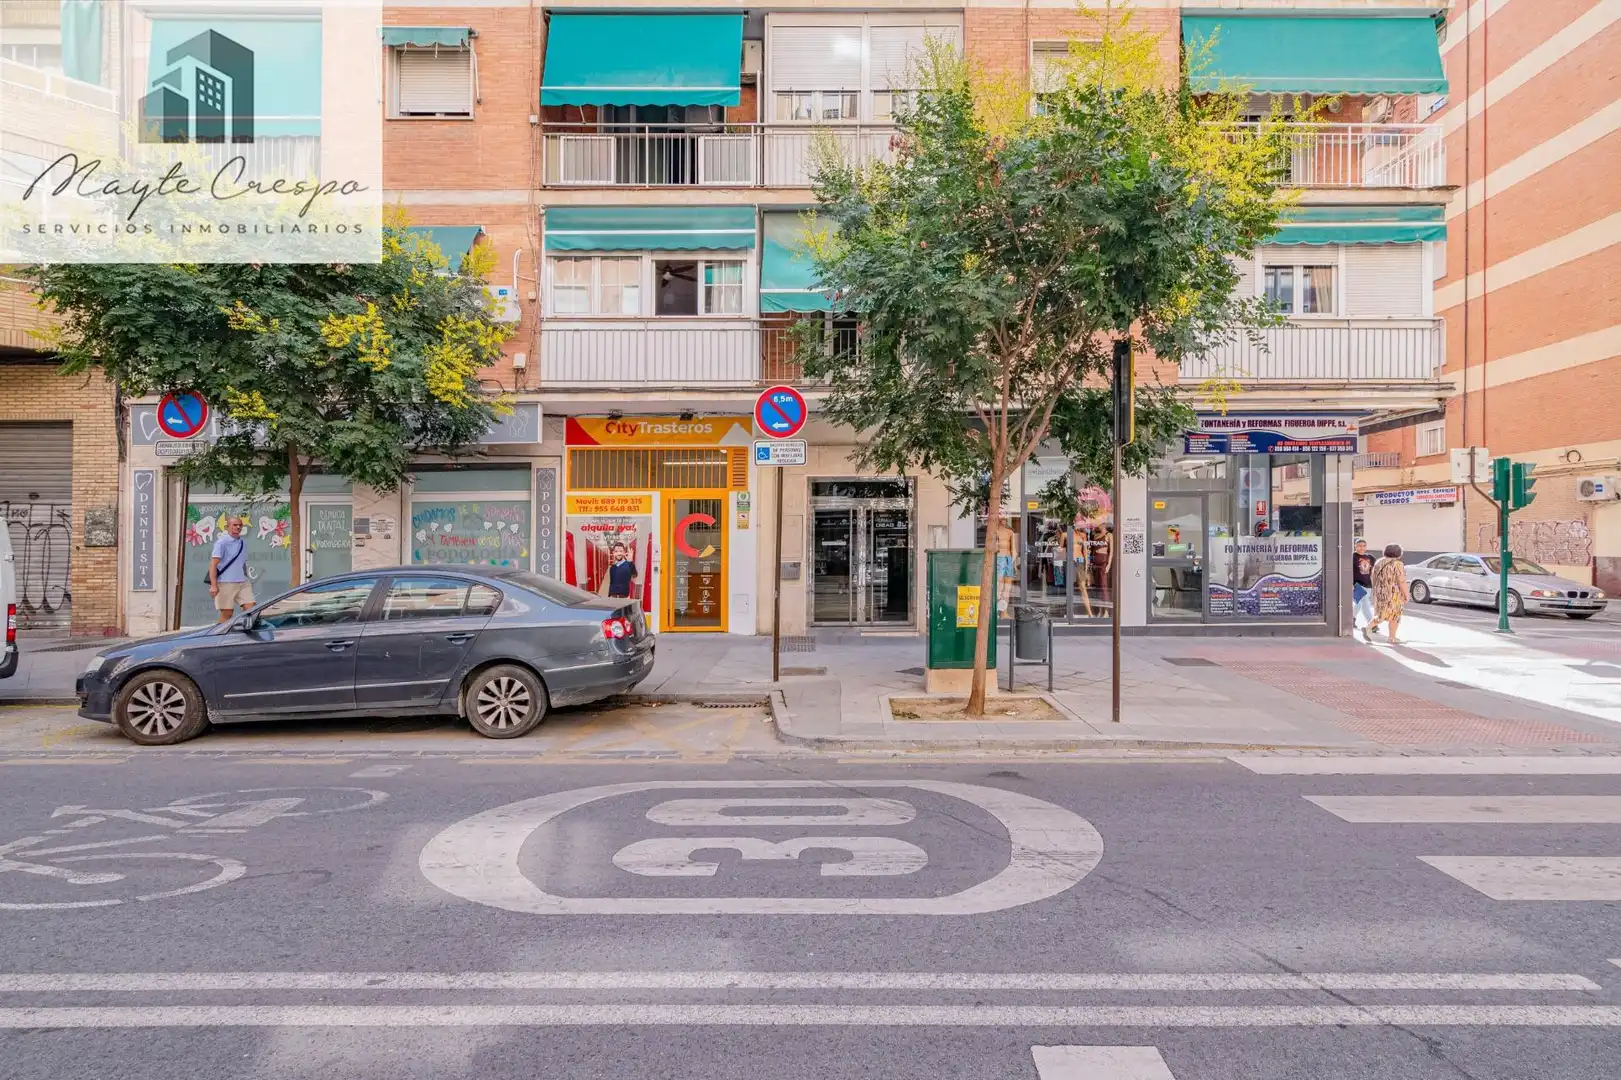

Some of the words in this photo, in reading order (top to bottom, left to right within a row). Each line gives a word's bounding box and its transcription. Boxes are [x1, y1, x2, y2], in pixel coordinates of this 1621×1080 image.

[1247, 418, 1282, 428] REFORMAS
[1284, 418, 1315, 428] FIGUEROA
[605, 420, 712, 436] CityTrasteros
[1376, 490, 1414, 499] PRODUCTOS
[581, 524, 614, 532] alquila
[138, 493, 148, 588] DENTISTA
[1280, 544, 1318, 553] REFORMAS
